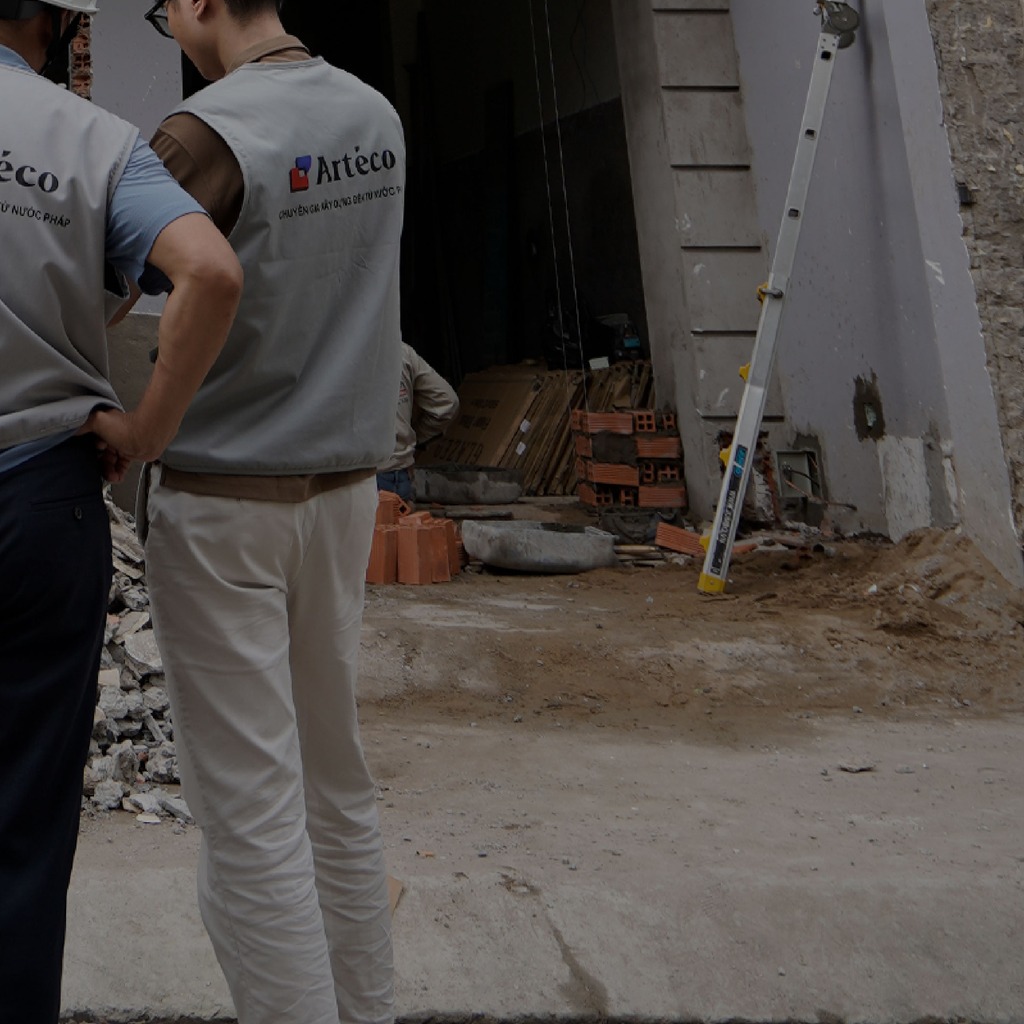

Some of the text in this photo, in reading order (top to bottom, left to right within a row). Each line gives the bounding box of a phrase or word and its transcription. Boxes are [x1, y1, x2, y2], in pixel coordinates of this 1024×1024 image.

[316, 145, 396, 185] Artéco
[11, 204, 41, 220] NƯỚC
[42, 212, 71, 227] PHÁP
